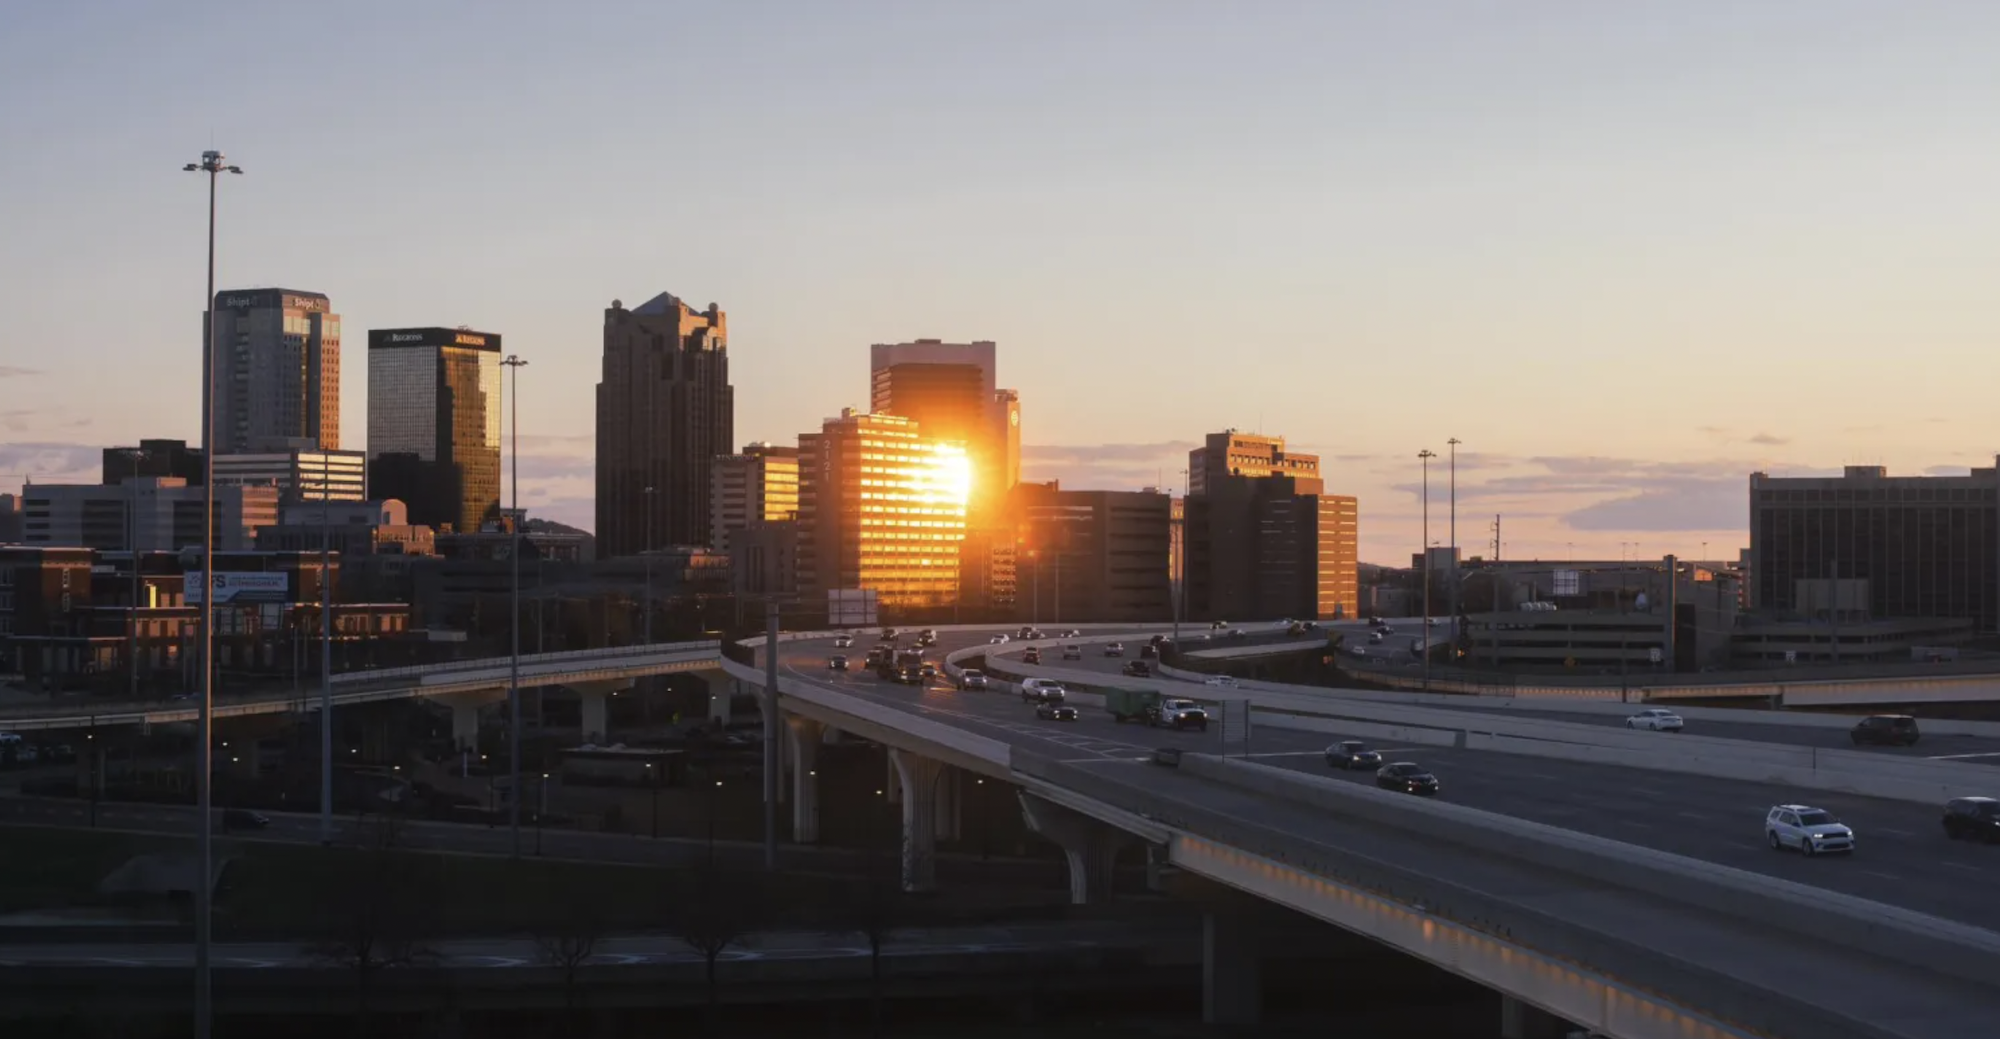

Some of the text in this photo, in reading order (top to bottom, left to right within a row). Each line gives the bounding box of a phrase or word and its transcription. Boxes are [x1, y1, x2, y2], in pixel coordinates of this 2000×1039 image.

[227, 297, 250, 308] Shipt
[294, 297, 314, 310] Shipt
[823, 439, 832, 482] 2121
